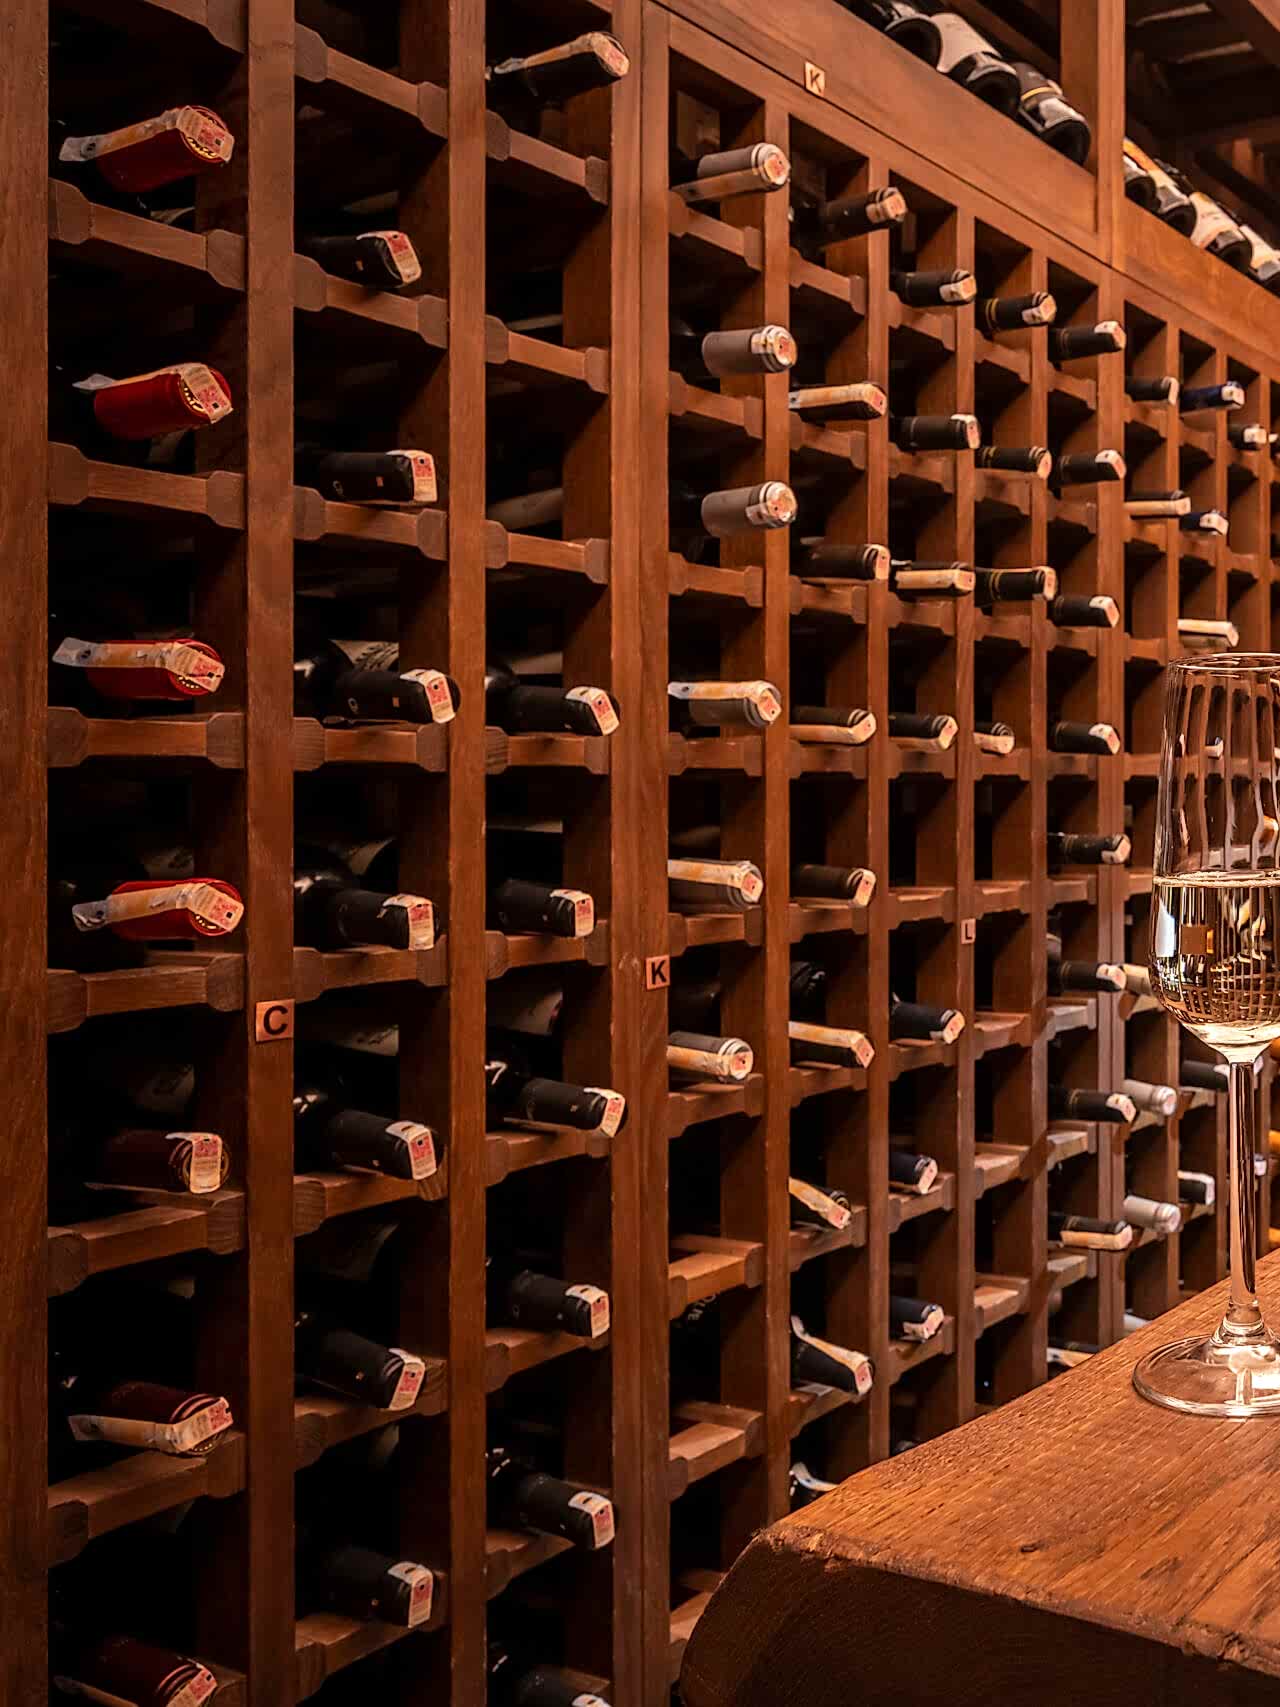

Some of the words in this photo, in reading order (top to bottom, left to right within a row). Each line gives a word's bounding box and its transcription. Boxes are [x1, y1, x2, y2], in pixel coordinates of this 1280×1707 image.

[810, 69, 821, 93] K
[965, 922, 973, 940] L
[651, 959, 667, 985] K
[263, 1004, 289, 1036] C
